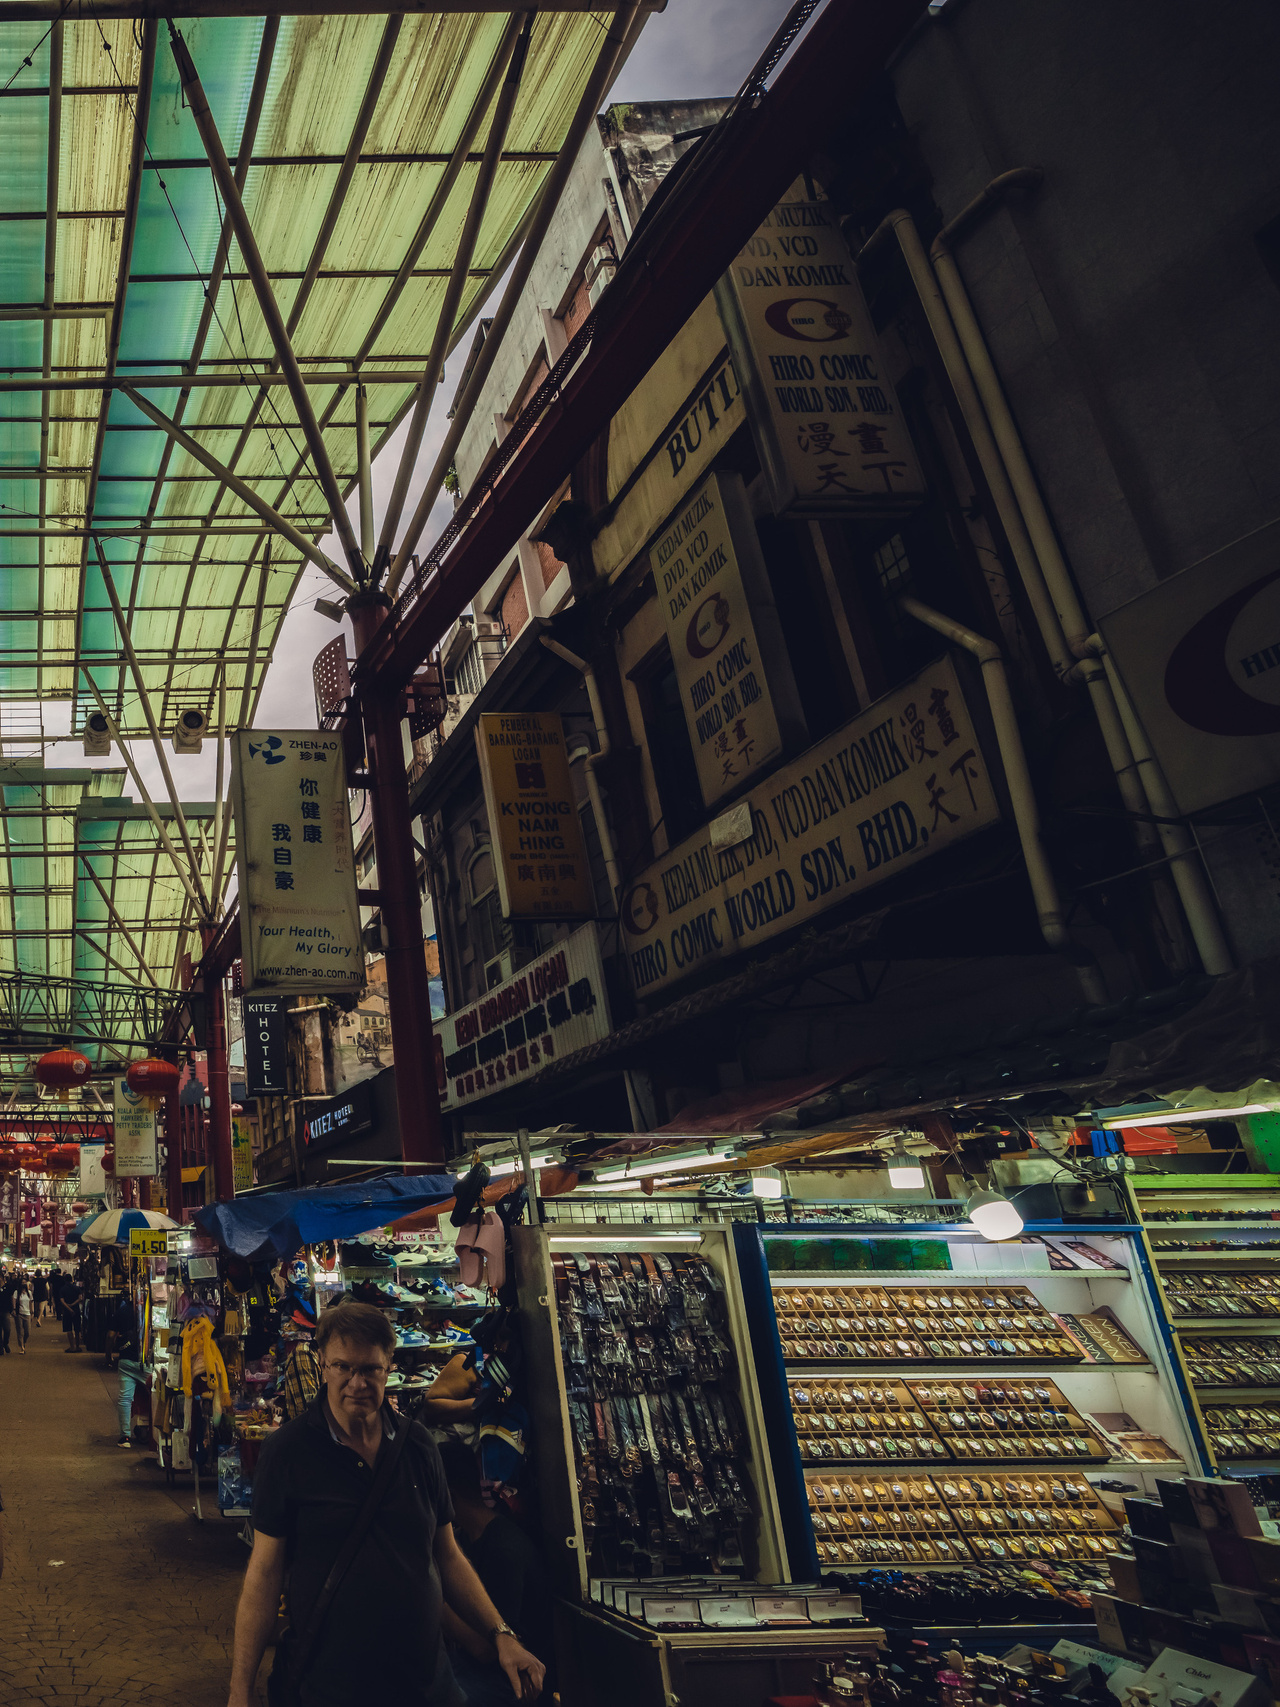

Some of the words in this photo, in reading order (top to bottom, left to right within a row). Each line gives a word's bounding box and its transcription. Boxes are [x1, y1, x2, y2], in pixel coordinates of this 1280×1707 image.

[777, 235, 818, 257] VCD
[741, 266, 781, 287] DAN
[784, 265, 851, 286] KOMIK
[768, 355, 815, 381] HIRO
[819, 355, 878, 381] COMIC
[774, 387, 824, 412] WORLD
[825, 387, 858, 412] SDN.
[859, 386, 893, 412] BHD.
[814, 462, 908, 494] 天下
[657, 524, 684, 568] KEDAI
[681, 490, 715, 537] MUZIK,
[663, 556, 689, 594] DVD,
[685, 530, 709, 567] VCD
[668, 585, 692, 620] DAN
[690, 543, 728, 602] KOMIK
[690, 670, 715, 712] HIRO
[716, 637, 751, 687] COMIC
[695, 696, 722, 745] WORLD
[721, 686, 742, 724] SDN.
[739, 671, 762, 707] BHD.
[501, 719, 542, 731] PEMBEKAL
[289, 740, 338, 751] ZHEN-AO
[489, 732, 559, 746] BARANG-BARANG
[512, 748, 541, 760] LOGAM
[721, 739, 756, 785] 天下
[299, 778, 323, 844] 你健康
[501, 802, 570, 816] KWONG
[661, 855, 701, 914] KEDAI
[771, 783, 810, 844] VCD
[801, 758, 848, 826] DAN
[837, 716, 909, 805] KOMIK
[519, 818, 560, 832] NAM
[519, 836, 565, 850] HING
[271, 824, 295, 891] 我自豪
[631, 938, 668, 990] HIRO
[670, 907, 723, 969] COMIC
[724, 868, 796, 940] WORLD
[800, 835, 857, 902] SDN.
[856, 800, 930, 872] BHD.
[258, 925, 285, 937] Your
[289, 926, 335, 941] Health,
[295, 942, 313, 954] My
[317, 943, 352, 958] Glory
[259, 965, 365, 984] www.zhen-ao.com.my
[248, 1004, 278, 1013] KITEZ
[259, 1017, 272, 1085] HOTEL
[310, 1112, 333, 1139] KITEZ
[132, 1242, 141, 1250] RM
[1079, 1318, 1125, 1358] NAKED
[1097, 1318, 1141, 1358] NAKED
[1185, 1666, 1211, 1681] Chloé
